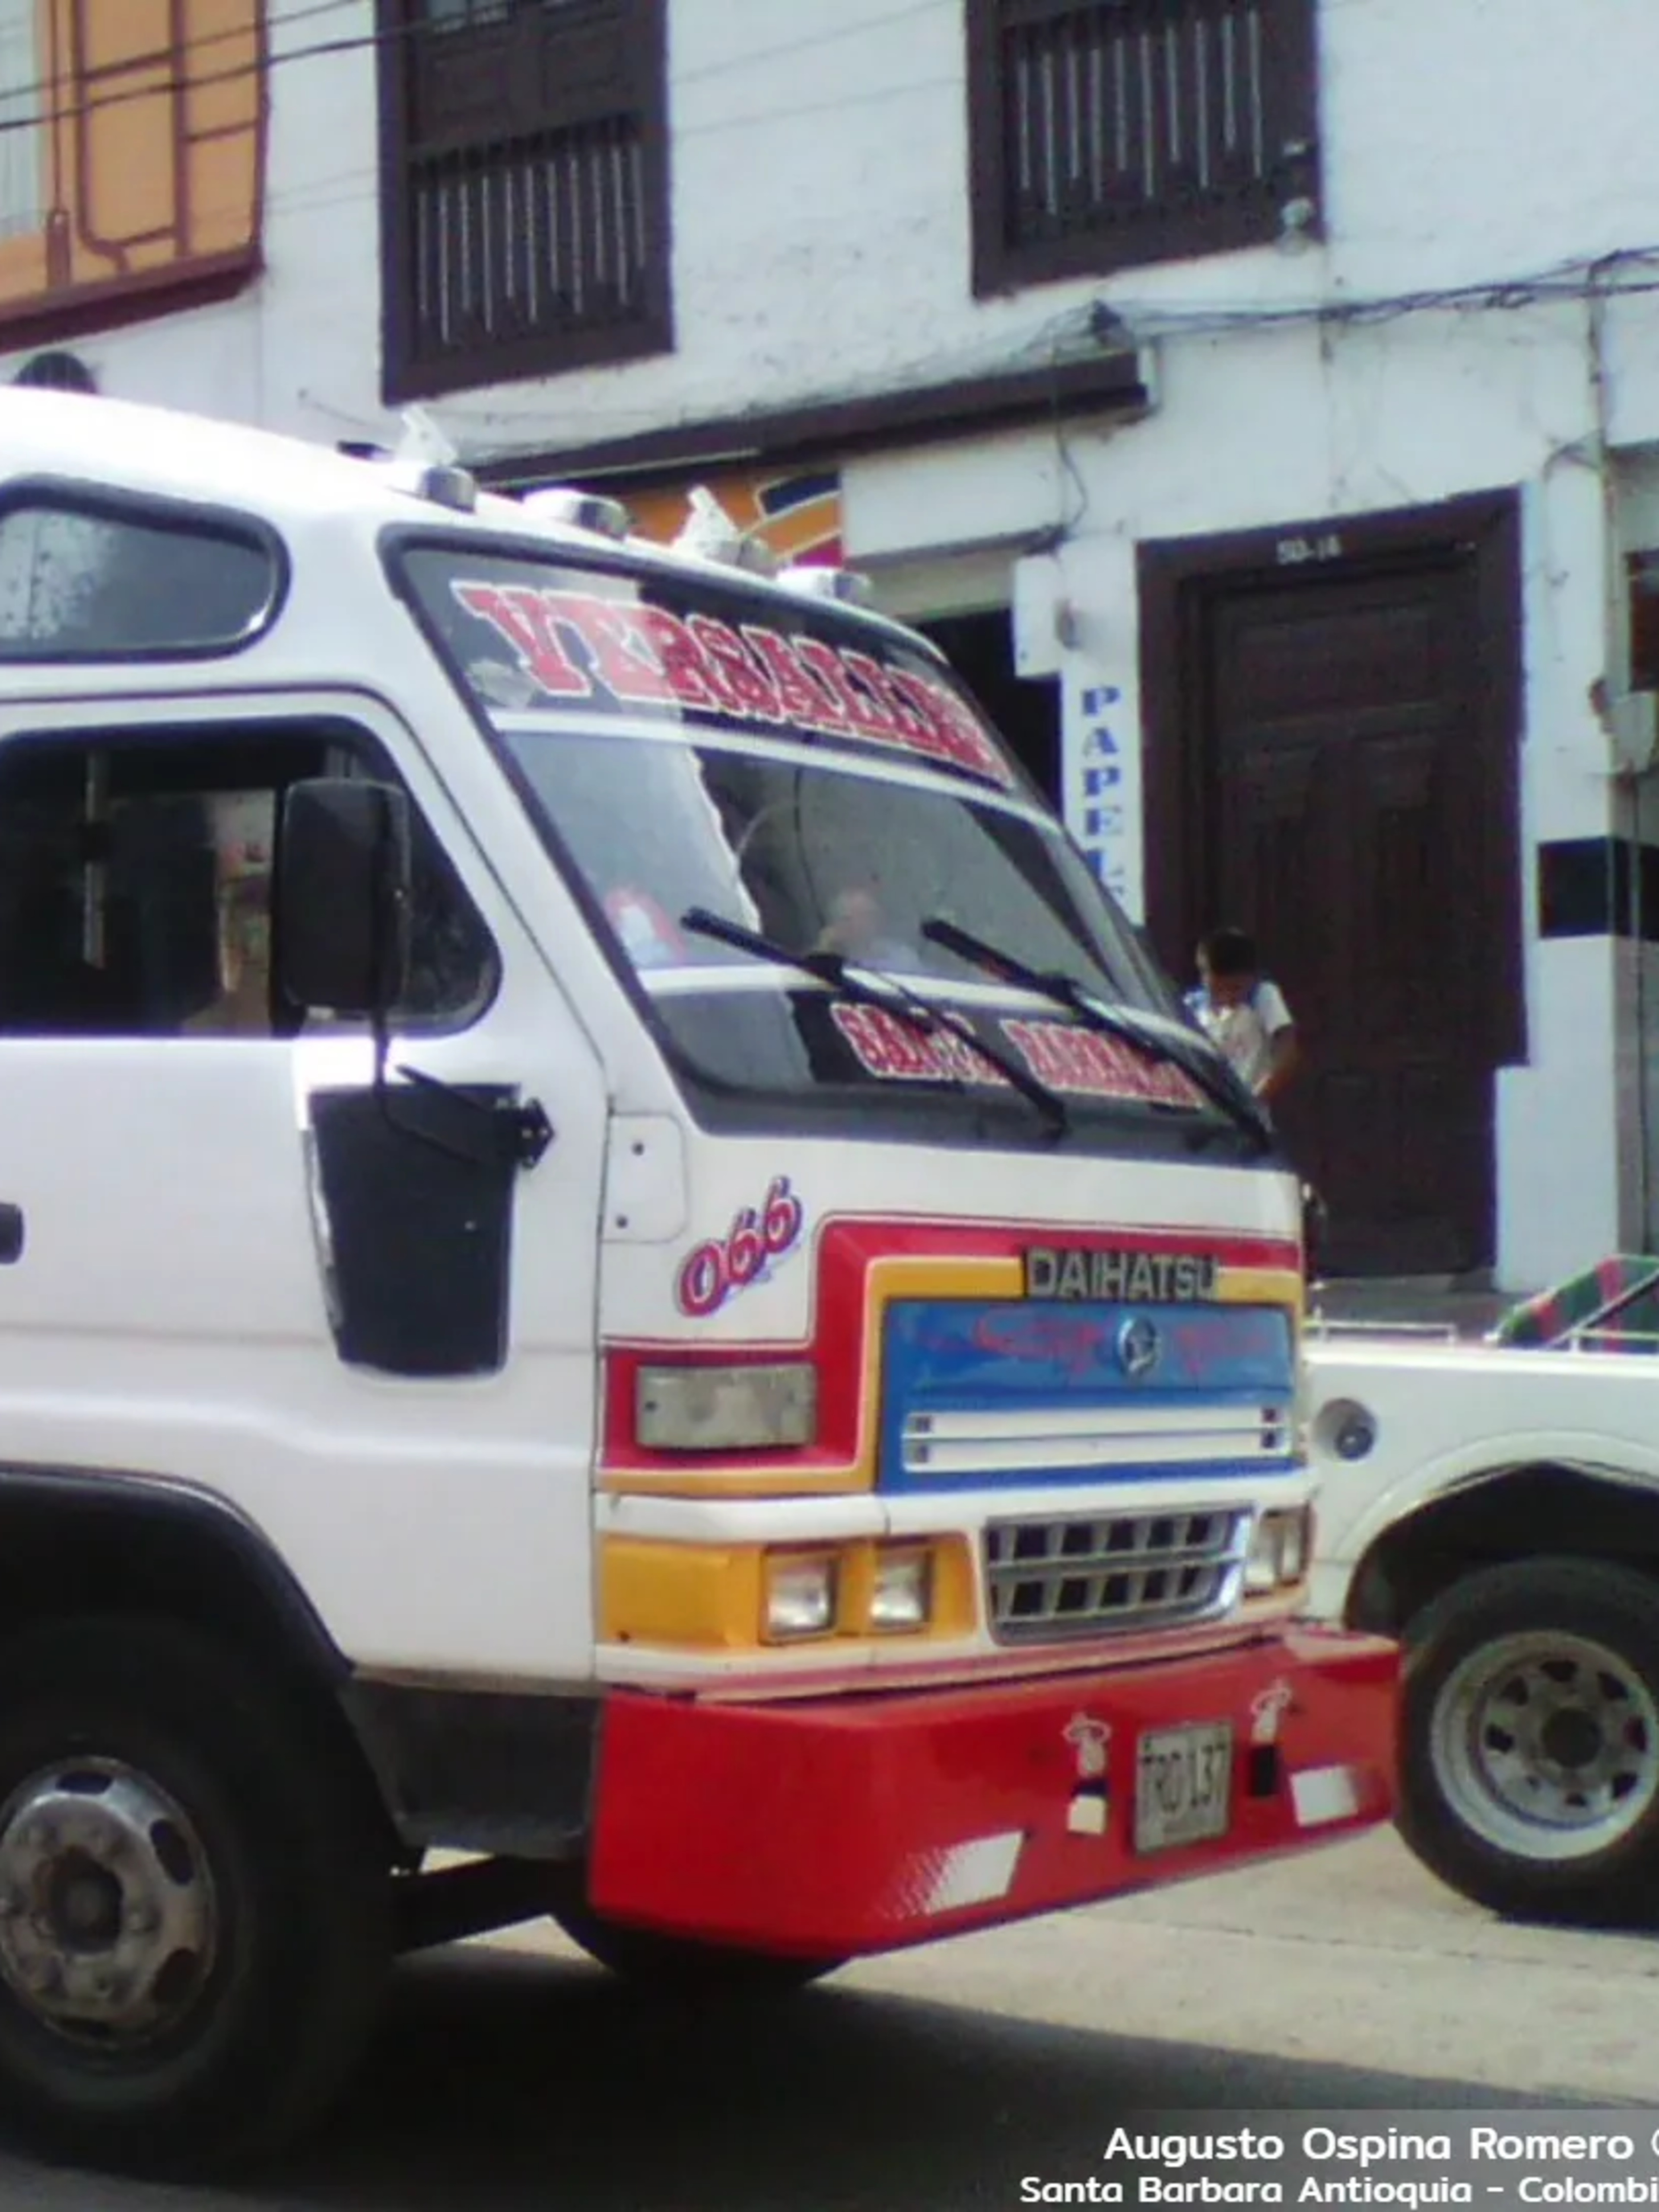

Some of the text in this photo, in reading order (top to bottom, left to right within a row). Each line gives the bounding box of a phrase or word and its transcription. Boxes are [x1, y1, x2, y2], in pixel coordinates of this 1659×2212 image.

[448, 580, 1014, 790] VERSALLES
[1082, 685, 1124, 897] PAPEL
[673, 1174, 804, 1319] 066
[1027, 1249, 1218, 1301] DAIHATSU
